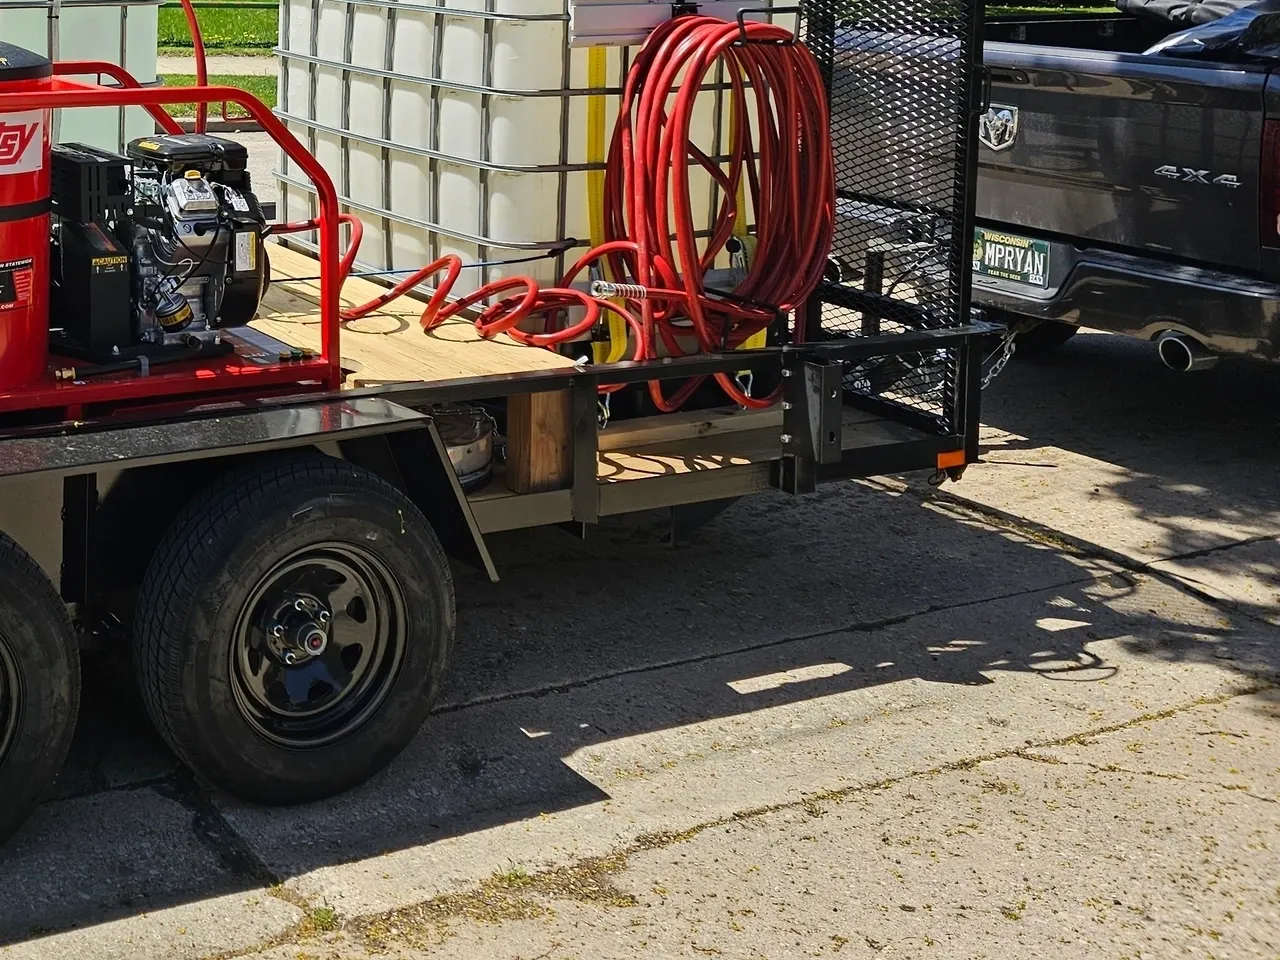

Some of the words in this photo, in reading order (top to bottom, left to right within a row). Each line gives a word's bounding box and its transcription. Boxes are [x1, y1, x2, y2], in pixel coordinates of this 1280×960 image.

[983, 232, 1030, 248] WISCONSIN
[5, 258, 33, 268] STATEWIDE
[98, 256, 127, 265] CAUTION
[984, 242, 1045, 276] MPRYAN
[987, 269, 1000, 277] FEAR
[1000, 271, 1009, 279] THE
